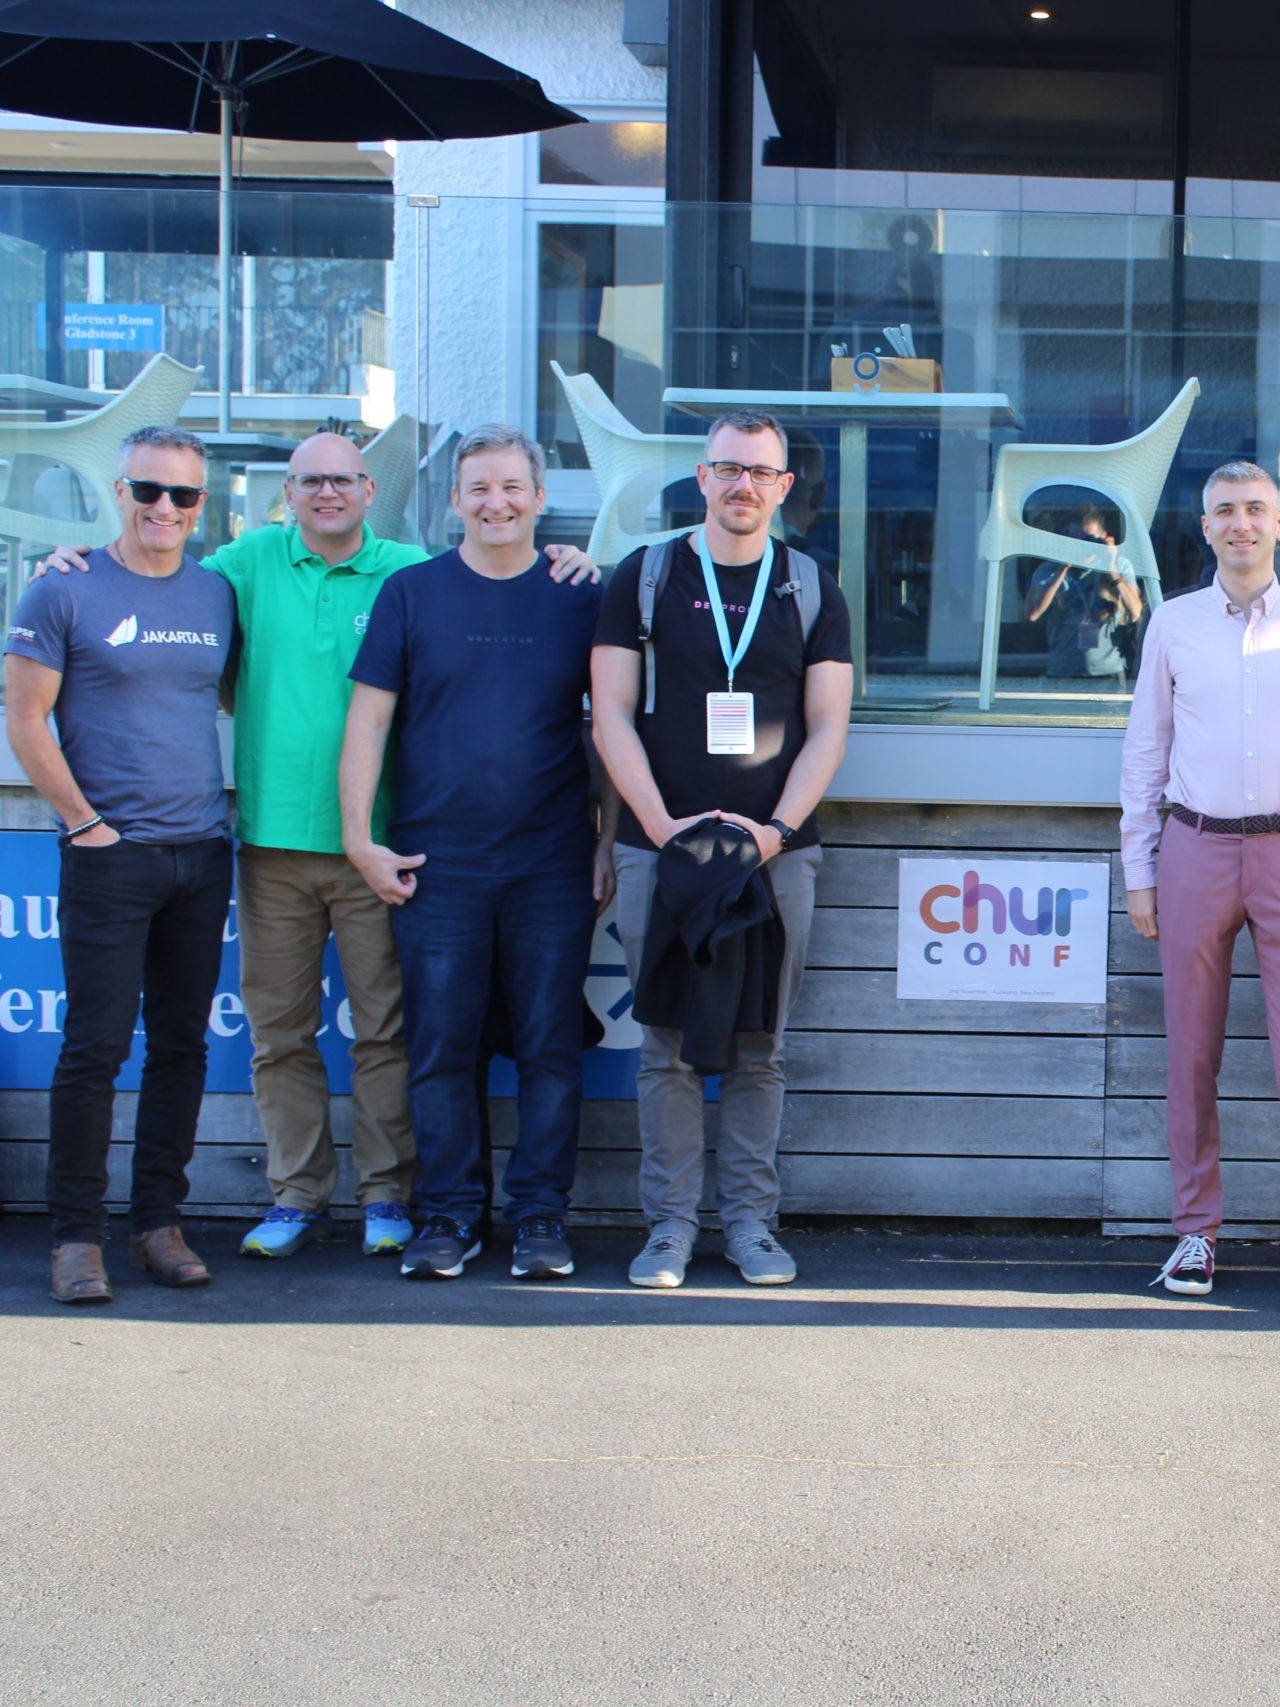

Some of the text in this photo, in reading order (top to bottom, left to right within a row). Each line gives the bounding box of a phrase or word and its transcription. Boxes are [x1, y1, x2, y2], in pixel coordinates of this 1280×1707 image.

[64, 313, 154, 326] nference Room
[65, 327, 136, 340] Gladstone 3
[140, 630, 219, 647] JAKARTA EE
[919, 870, 1089, 937] chur
[923, 941, 1071, 968] CONF
